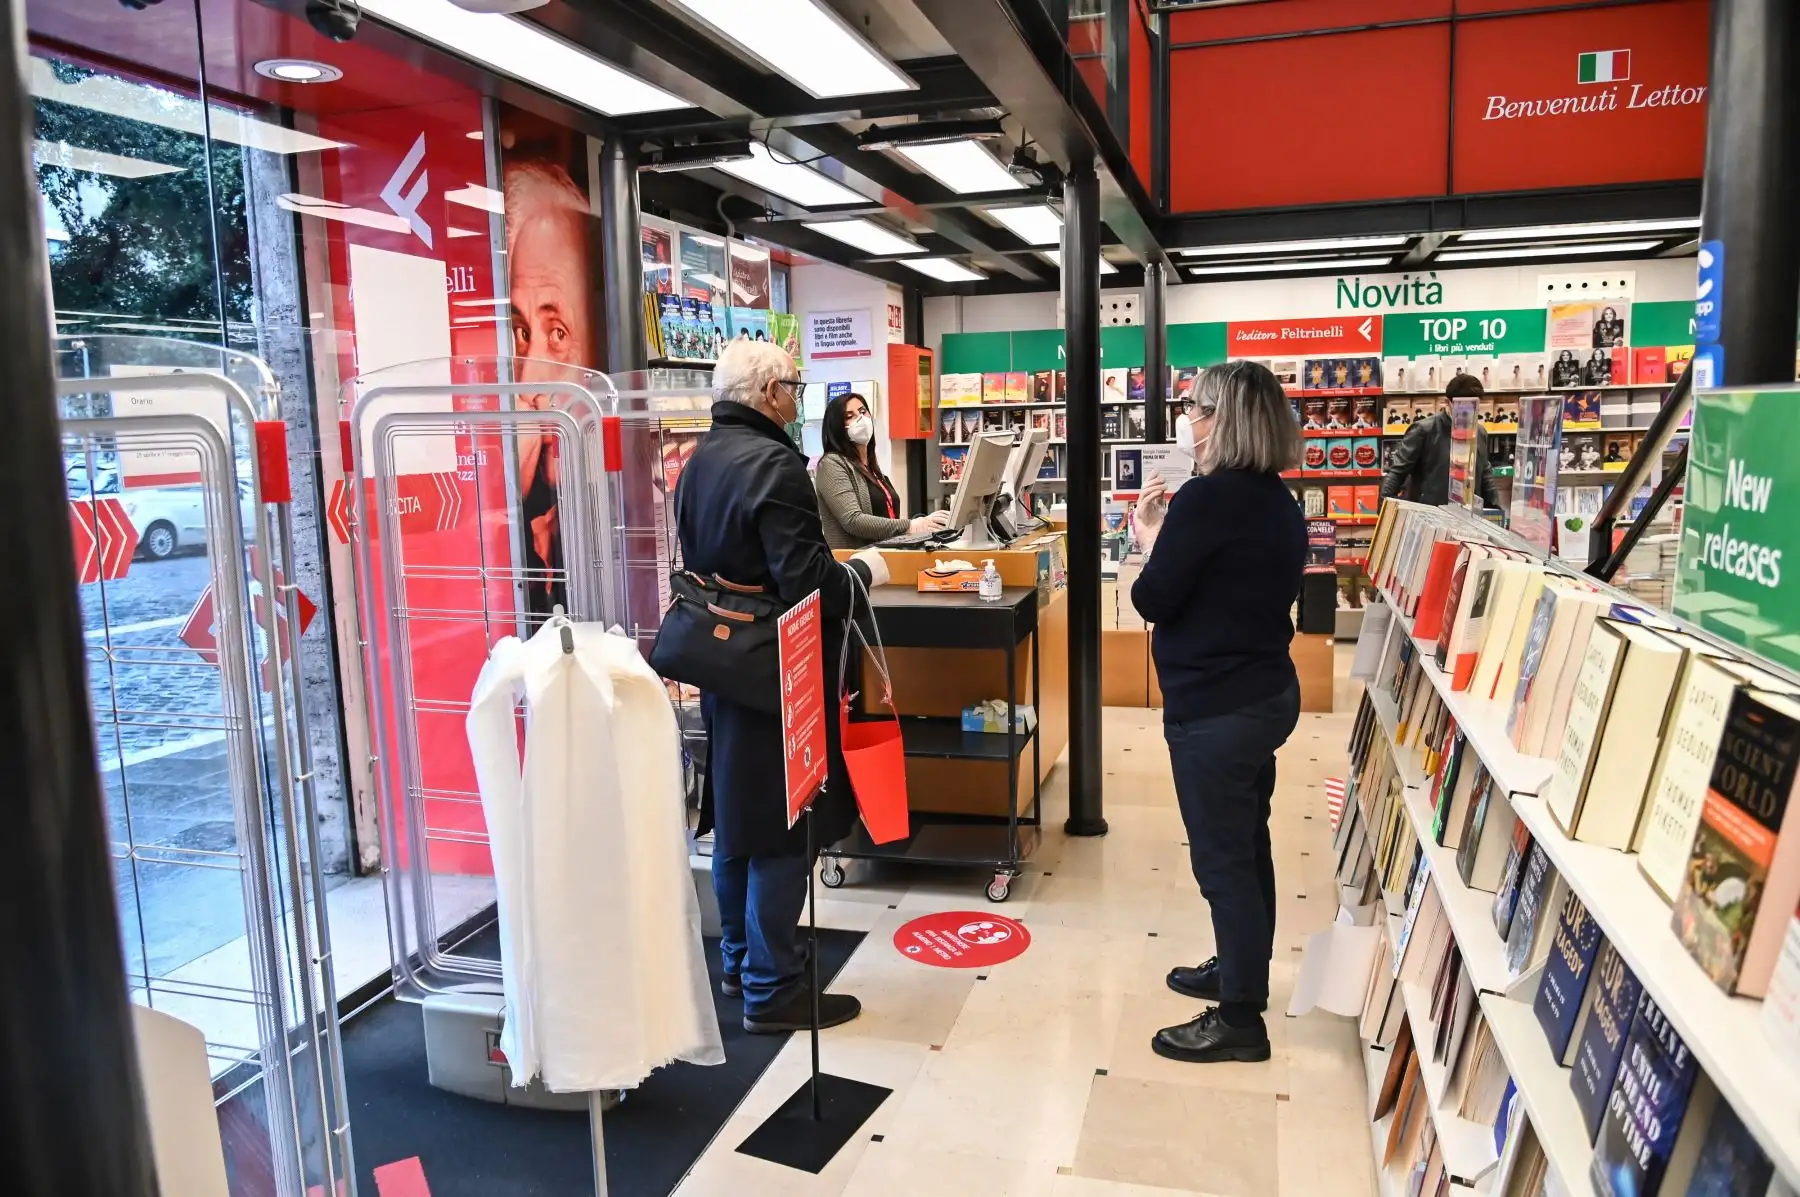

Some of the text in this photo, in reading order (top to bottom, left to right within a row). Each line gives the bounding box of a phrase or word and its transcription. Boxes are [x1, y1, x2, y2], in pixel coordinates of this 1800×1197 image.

[1481, 83, 1709, 121] Benvenuti Lettor
[1336, 271, 1443, 309] Novità
[819, 317, 835, 326] questa
[836, 316, 852, 324] libreria
[826, 324, 850, 332] disponibili
[1236, 326, 1343, 341] l'editore Feltrinelli
[1419, 318, 1507, 341] TOP 10
[1435, 343, 1448, 352] libri
[1450, 343, 1463, 353] più
[1465, 342, 1494, 352] venduti
[131, 397, 153, 405] Orario
[1724, 457, 1773, 514] New
[1702, 521, 1782, 588] releases
[1723, 731, 1786, 784] NCIENT
[1555, 926, 1585, 980] RAGEDY
[1594, 985, 1621, 1052] RAGEDY
[1631, 1041, 1663, 1106] UNTIL
[1617, 1060, 1662, 1143] THE END
[1611, 1089, 1652, 1172] OF TIME
